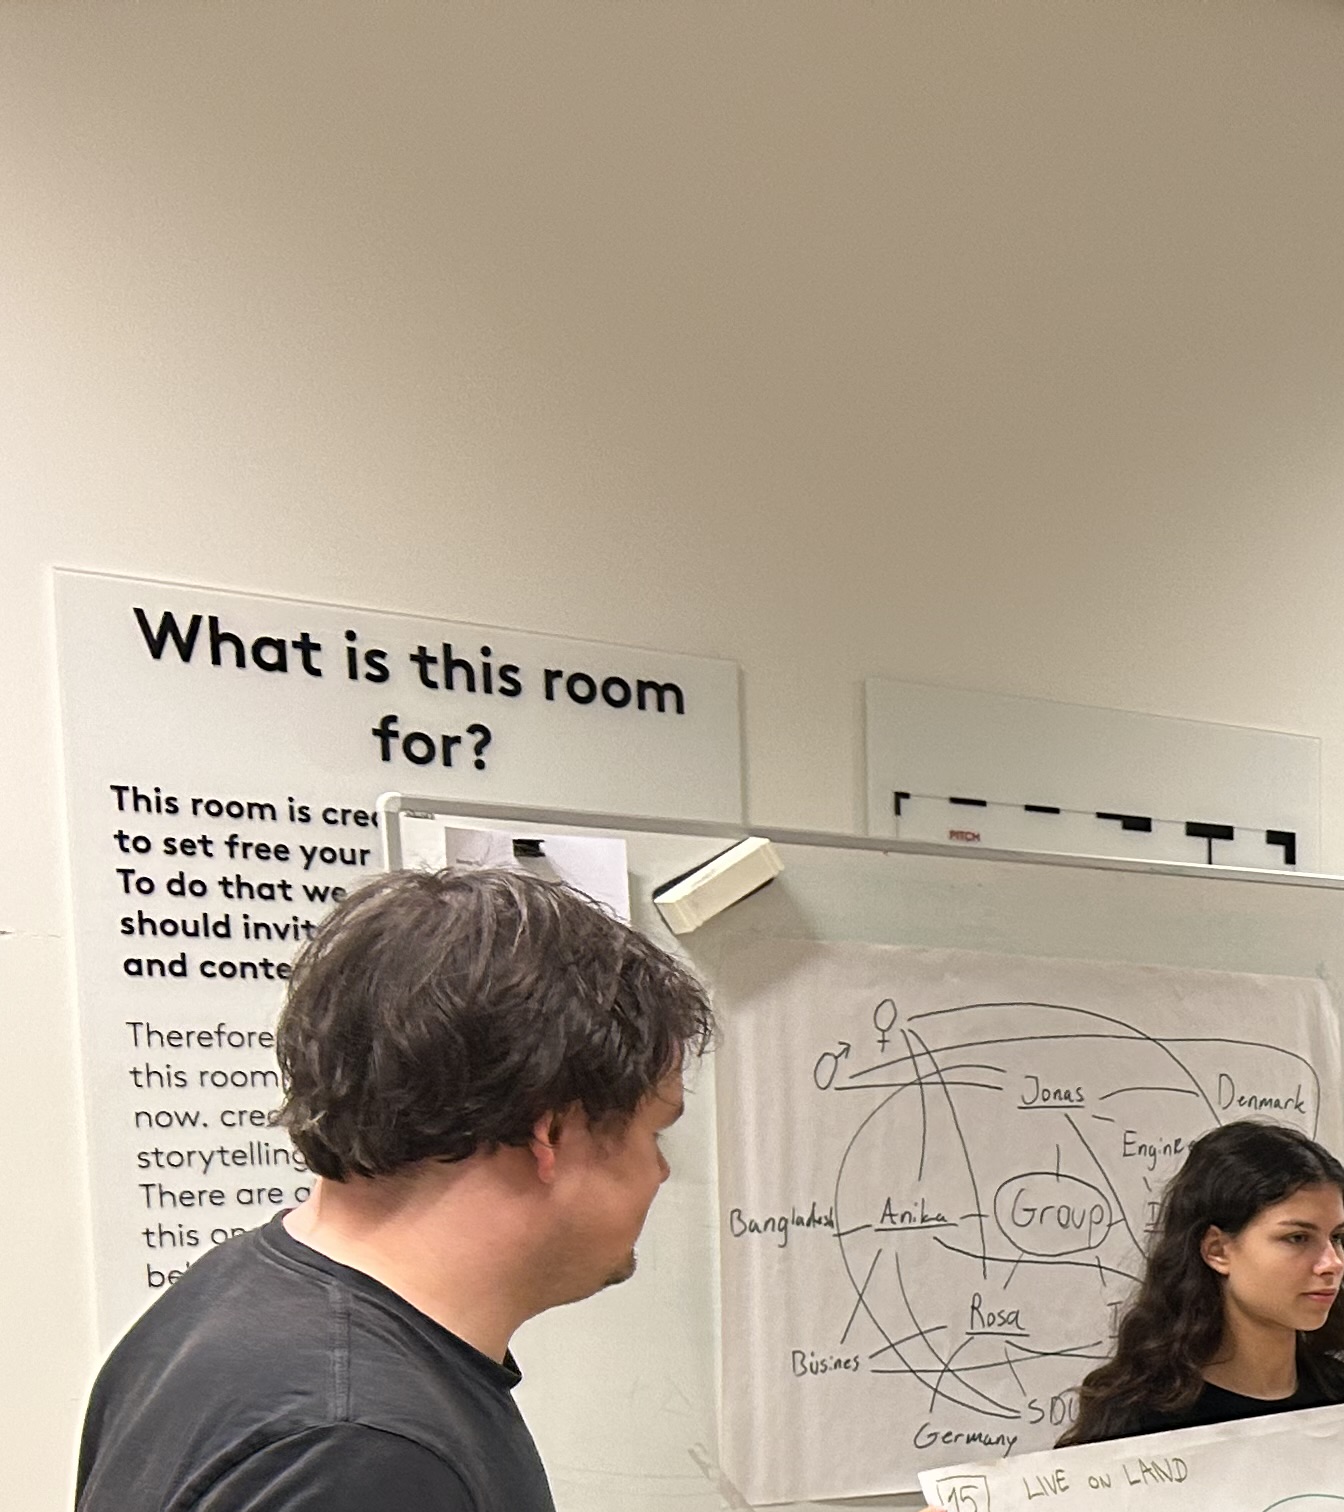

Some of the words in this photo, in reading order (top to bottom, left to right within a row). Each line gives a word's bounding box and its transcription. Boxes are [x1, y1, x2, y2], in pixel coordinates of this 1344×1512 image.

[133, 608, 322, 678] What
[344, 629, 391, 684] is
[409, 643, 523, 698] this
[543, 667, 686, 714] room
[372, 714, 493, 770] for?
[110, 784, 179, 815] This
[191, 797, 277, 821] room
[288, 796, 312, 823] is
[322, 806, 378, 828] cre
[113, 829, 151, 854] to
[163, 834, 214, 857] set
[224, 833, 290, 861] free
[299, 844, 371, 870] your
[116, 868, 155, 895] To
[166, 871, 208, 897] do
[218, 874, 293, 901] that
[303, 883, 348, 903] we
[120, 910, 231, 939] should
[242, 914, 319, 942] invit
[123, 952, 188, 977] and
[199, 957, 292, 980] conte
[125, 1021, 276, 1049] Therefore
[129, 1062, 188, 1090] this
[199, 1067, 280, 1088] room
[1021, 1075, 1085, 1105] Jonas
[1218, 1073, 1307, 1115] Denmark
[134, 1109, 208, 1128] now.
[137, 1140, 309, 1174] storytelling
[138, 1182, 226, 1208] There
[236, 1184, 284, 1205] are
[879, 1196, 949, 1226] Anika
[142, 1223, 199, 1248] this
[1011, 1188, 1105, 1249] Group
[969, 1292, 1026, 1331] Rosa
[913, 1422, 1018, 1459] Germany
[1023, 1469, 1070, 1500] LIVE
[1122, 1457, 1188, 1486] LAND
